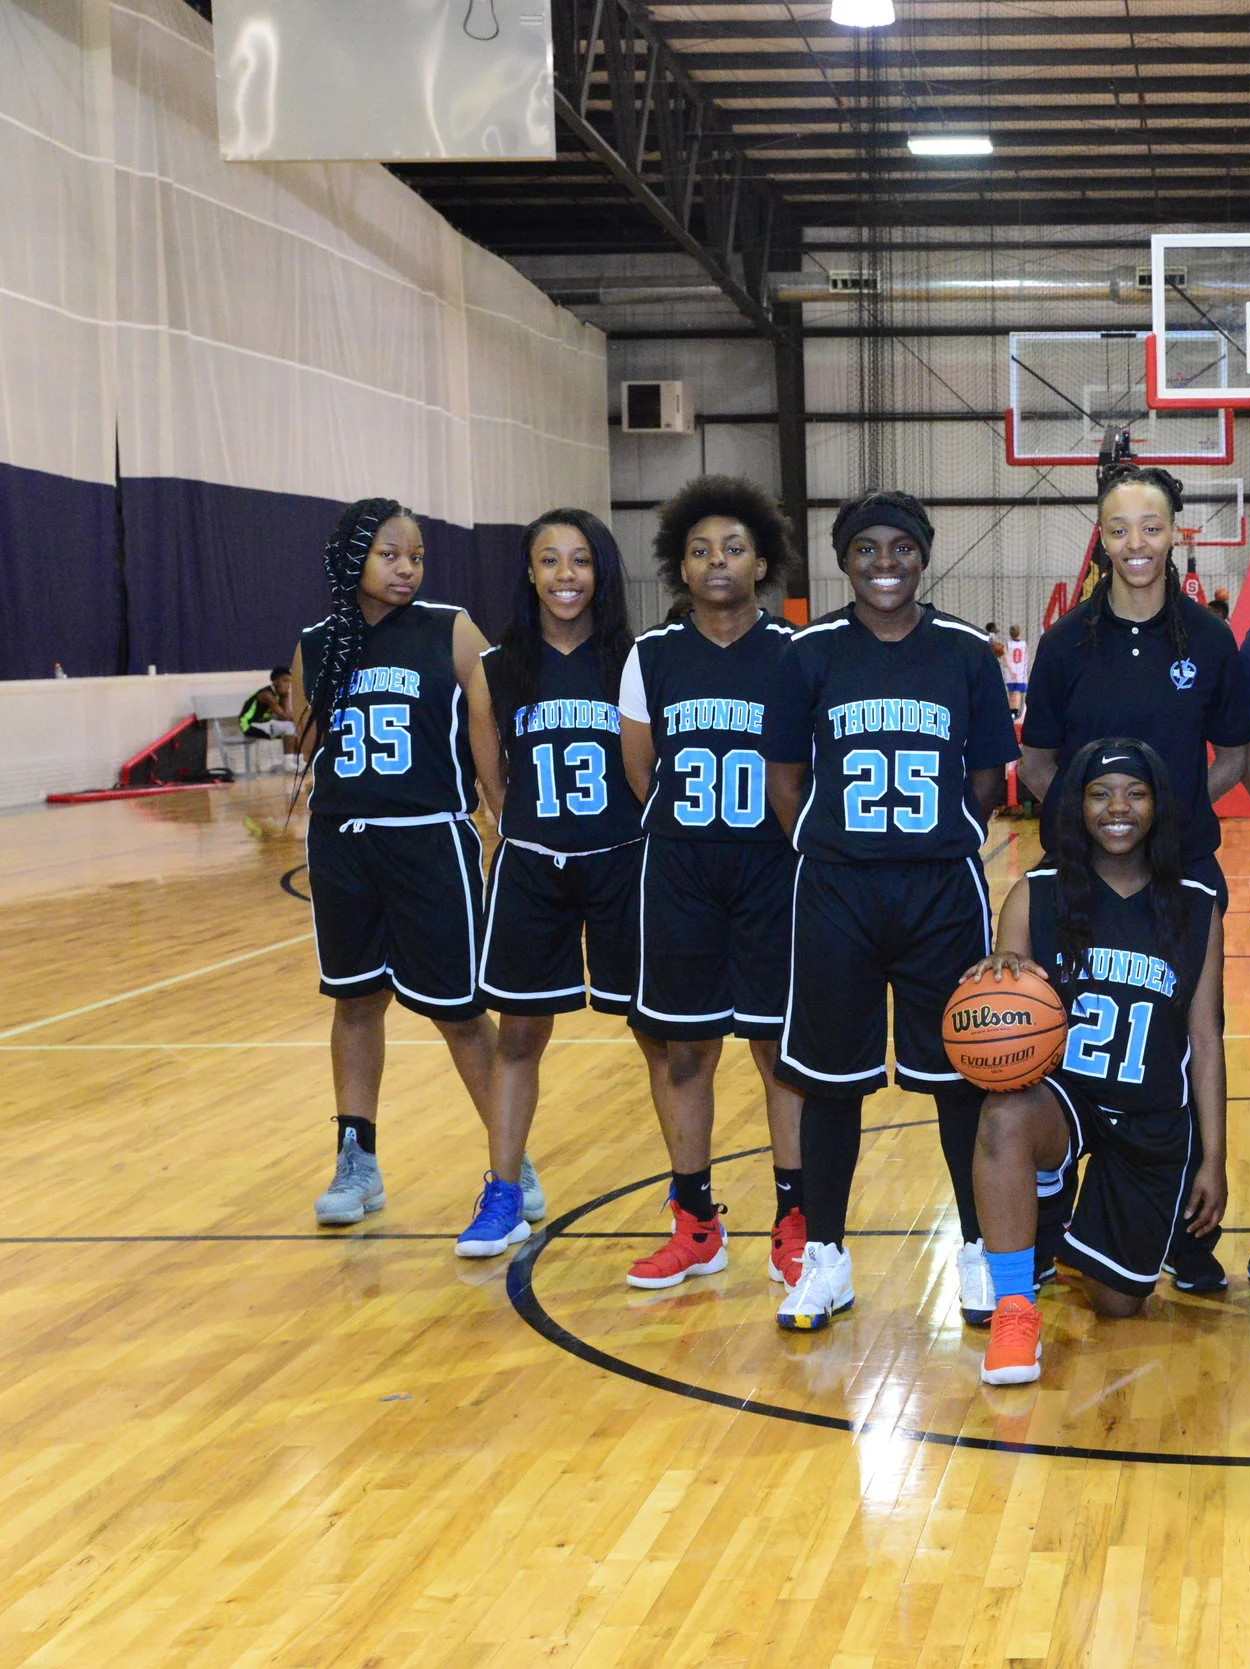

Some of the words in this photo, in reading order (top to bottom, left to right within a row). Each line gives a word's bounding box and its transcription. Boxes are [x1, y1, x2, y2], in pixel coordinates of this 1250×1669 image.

[336, 666, 420, 698] UNDER
[514, 699, 620, 737] THUNDER
[664, 698, 764, 736] THUNDE
[828, 698, 951, 741] THUNDER
[329, 703, 413, 779] 35
[532, 741, 608, 818] 13
[673, 747, 766, 828] 30
[843, 749, 940, 834] 25
[1056, 947, 1177, 998] UNDER
[951, 1004, 1033, 1033] Wilson
[1062, 991, 1154, 1084] 21
[960, 1045, 1036, 1067] EVOLUTION
